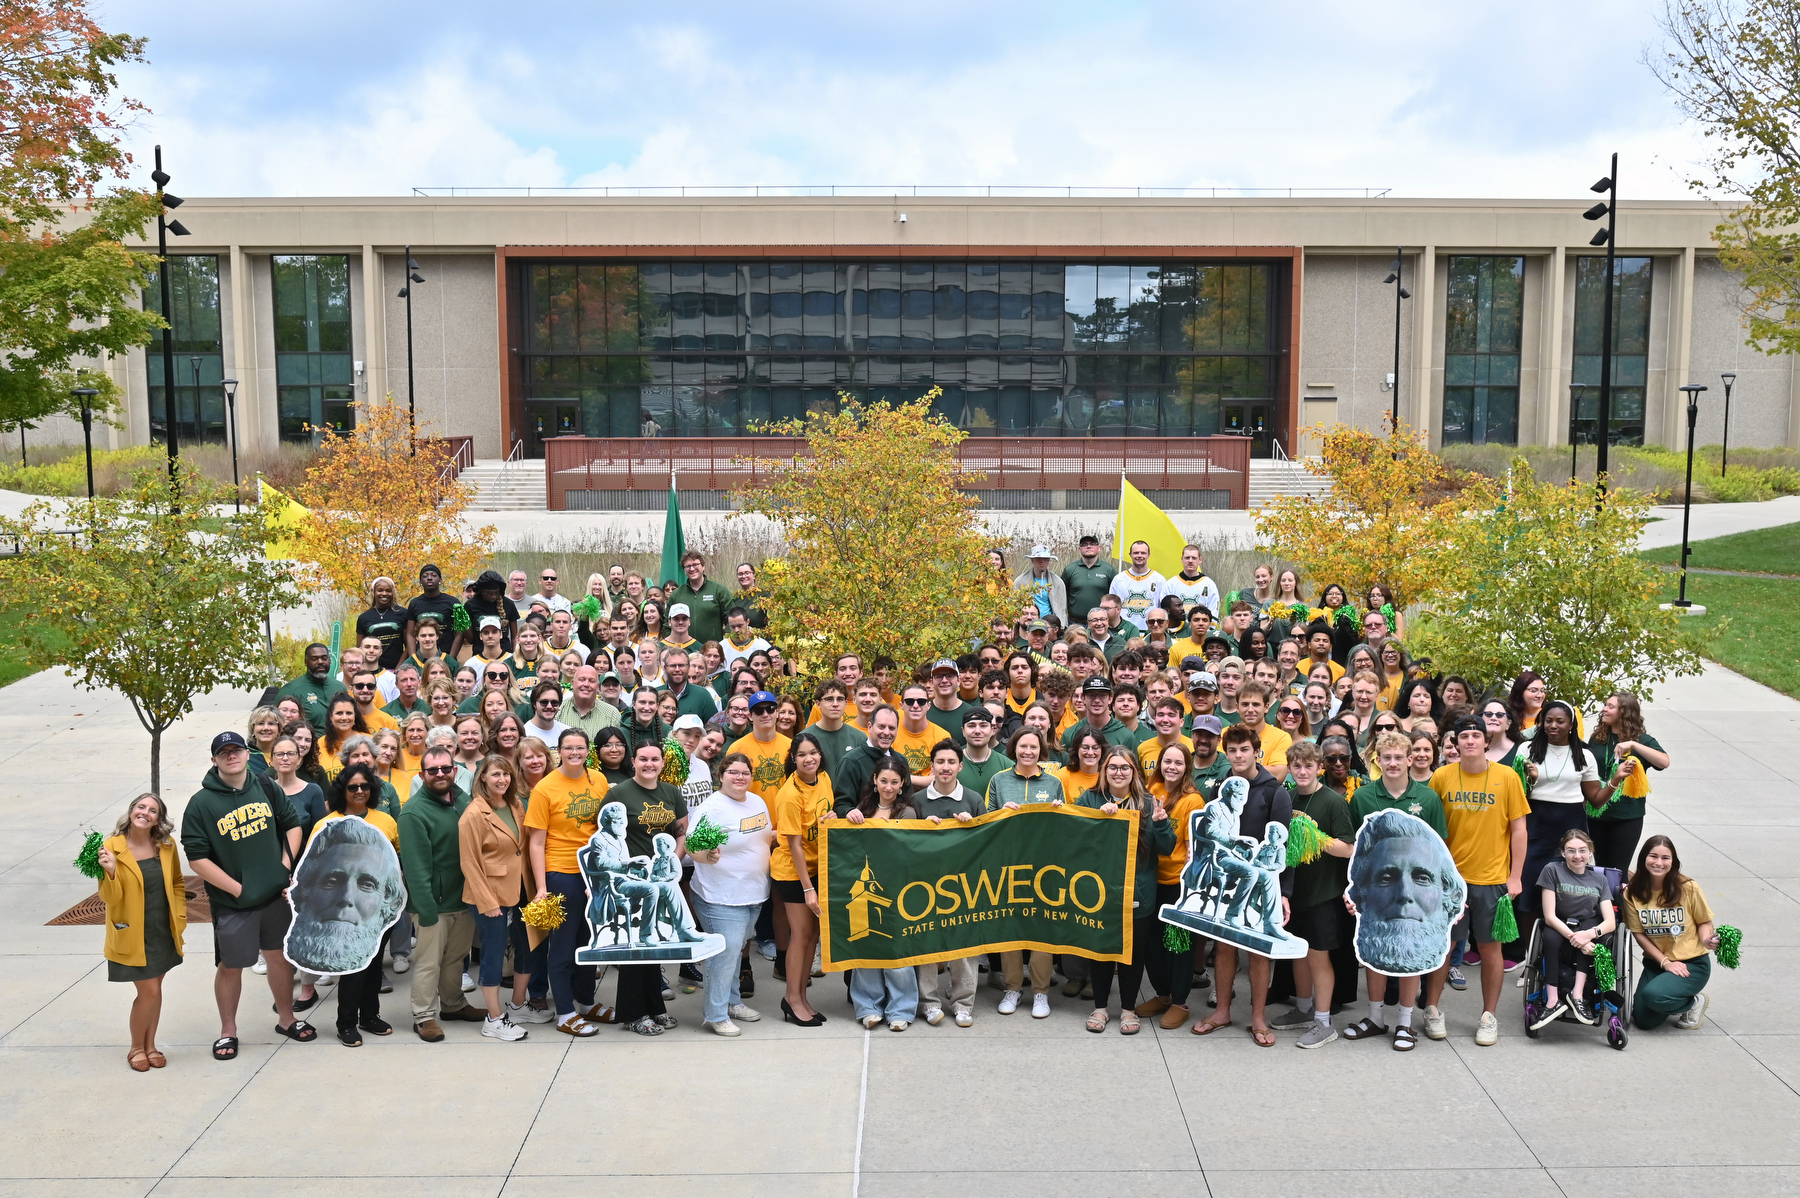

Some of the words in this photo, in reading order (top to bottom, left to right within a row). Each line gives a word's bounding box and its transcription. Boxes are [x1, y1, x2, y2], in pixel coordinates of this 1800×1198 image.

[1150, 582, 1157, 593] C
[1201, 585, 1209, 597] A
[1448, 791, 1495, 805] LAKERS
[1453, 804, 1489, 812] LACROSSE
[216, 802, 273, 836] OSWEGO
[230, 817, 268, 841] STATE
[897, 864, 1106, 921] OSWEGO
[902, 921, 935, 937] STATE
[941, 907, 1015, 928] UNIVERSITY
[1022, 907, 1037, 917] OF
[1044, 909, 1068, 921] NEW
[1074, 914, 1105, 930] YORK
[1636, 906, 1686, 926] SWEGO
[1645, 927, 1668, 935] UMNI
